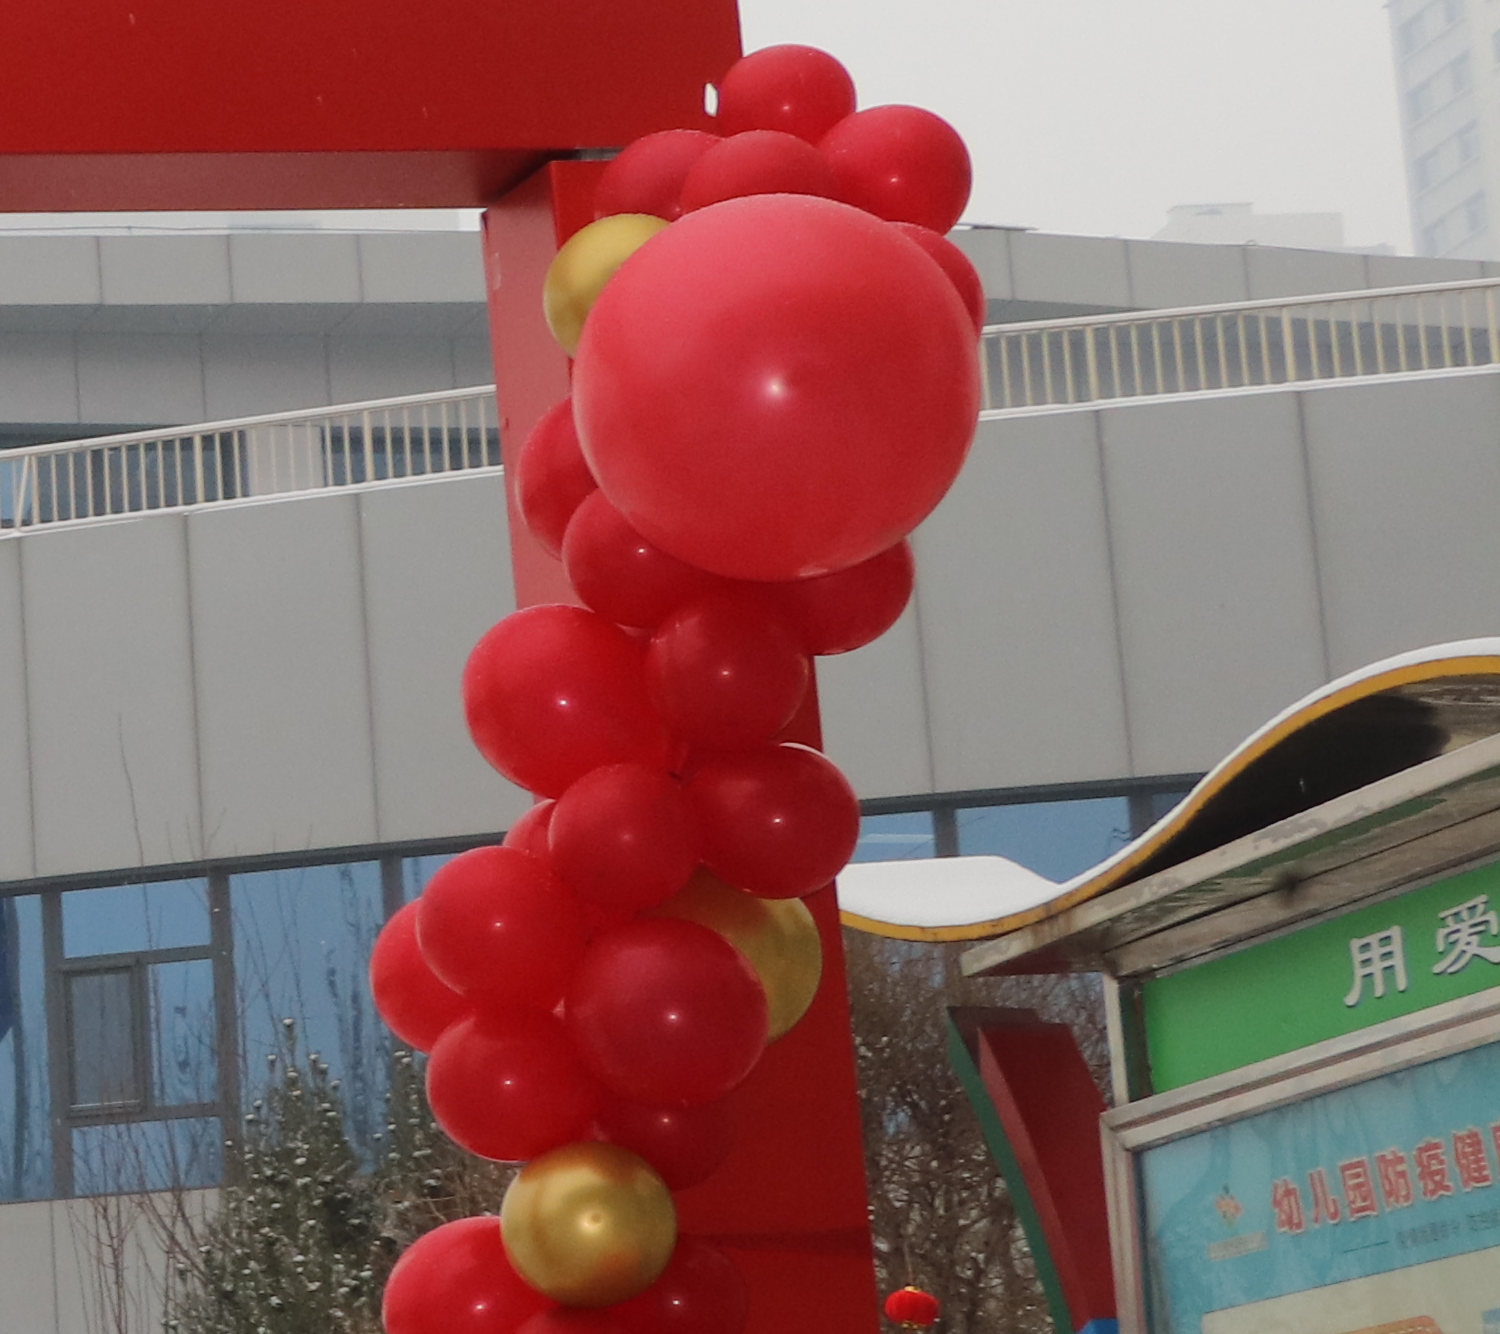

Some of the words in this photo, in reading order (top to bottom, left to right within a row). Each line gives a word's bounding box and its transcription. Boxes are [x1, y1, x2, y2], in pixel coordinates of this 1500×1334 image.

[1270, 1120, 1500, 1235] 幼儿园防疫健
